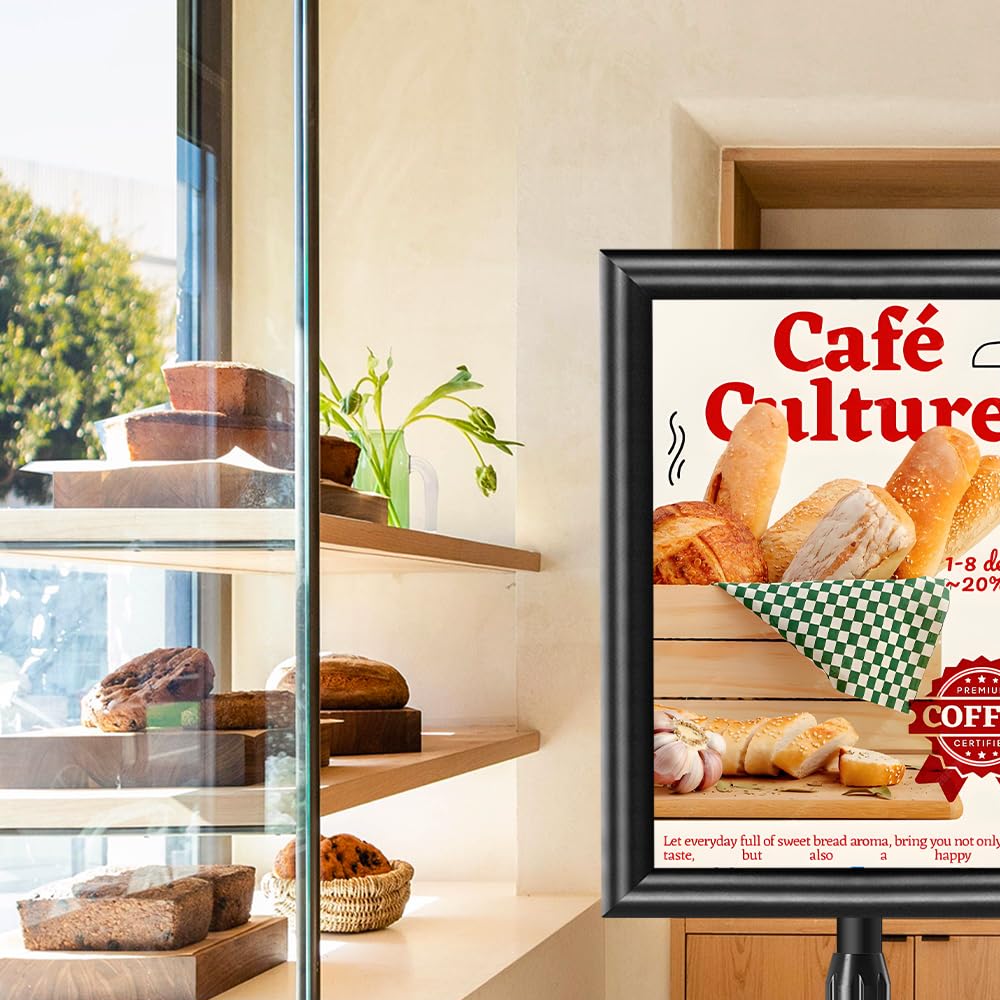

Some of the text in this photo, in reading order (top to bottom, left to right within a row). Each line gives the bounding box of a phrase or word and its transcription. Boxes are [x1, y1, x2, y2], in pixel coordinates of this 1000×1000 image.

[773, 303, 945, 373] Café
[945, 556, 977, 572] 1-8
[663, 835, 682, 847] Let
[684, 835, 738, 849] everyday
[740, 834, 761, 847] full
[763, 834, 777, 847] of
[777, 837, 811, 847] sweet
[813, 834, 847, 847] bread
[850, 838, 892, 849] aroma,
[894, 834, 928, 849] bring
[929, 837, 951, 849] you
[954, 837, 975, 847] not
[663, 851, 695, 862] taste,
[742, 849, 762, 861] but
[809, 849, 834, 861] also
[880, 852, 887, 861] a
[934, 849, 972, 864] happy
